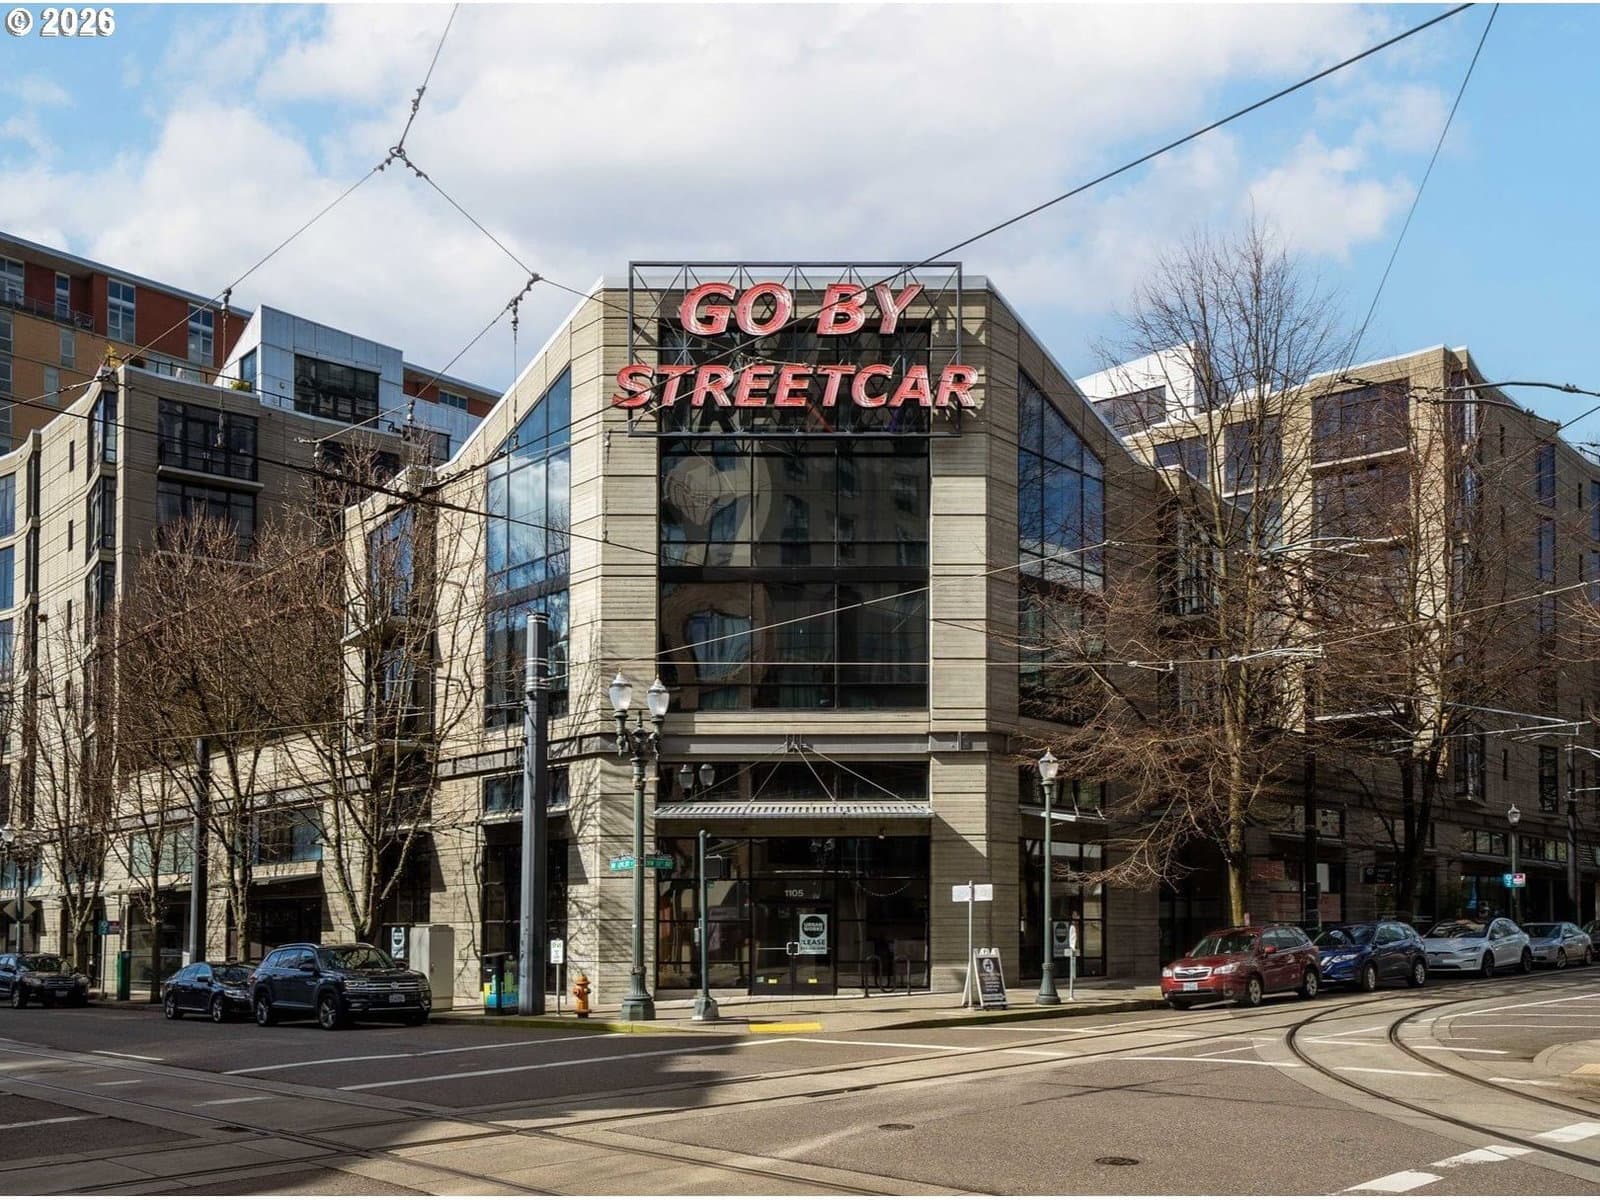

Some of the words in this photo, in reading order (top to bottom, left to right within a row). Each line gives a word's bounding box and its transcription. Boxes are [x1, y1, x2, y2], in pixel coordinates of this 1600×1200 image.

[680, 282, 793, 336] GO
[816, 282, 926, 335] BY
[612, 364, 980, 409] STREETCAR
[784, 889, 804, 897] 1105
